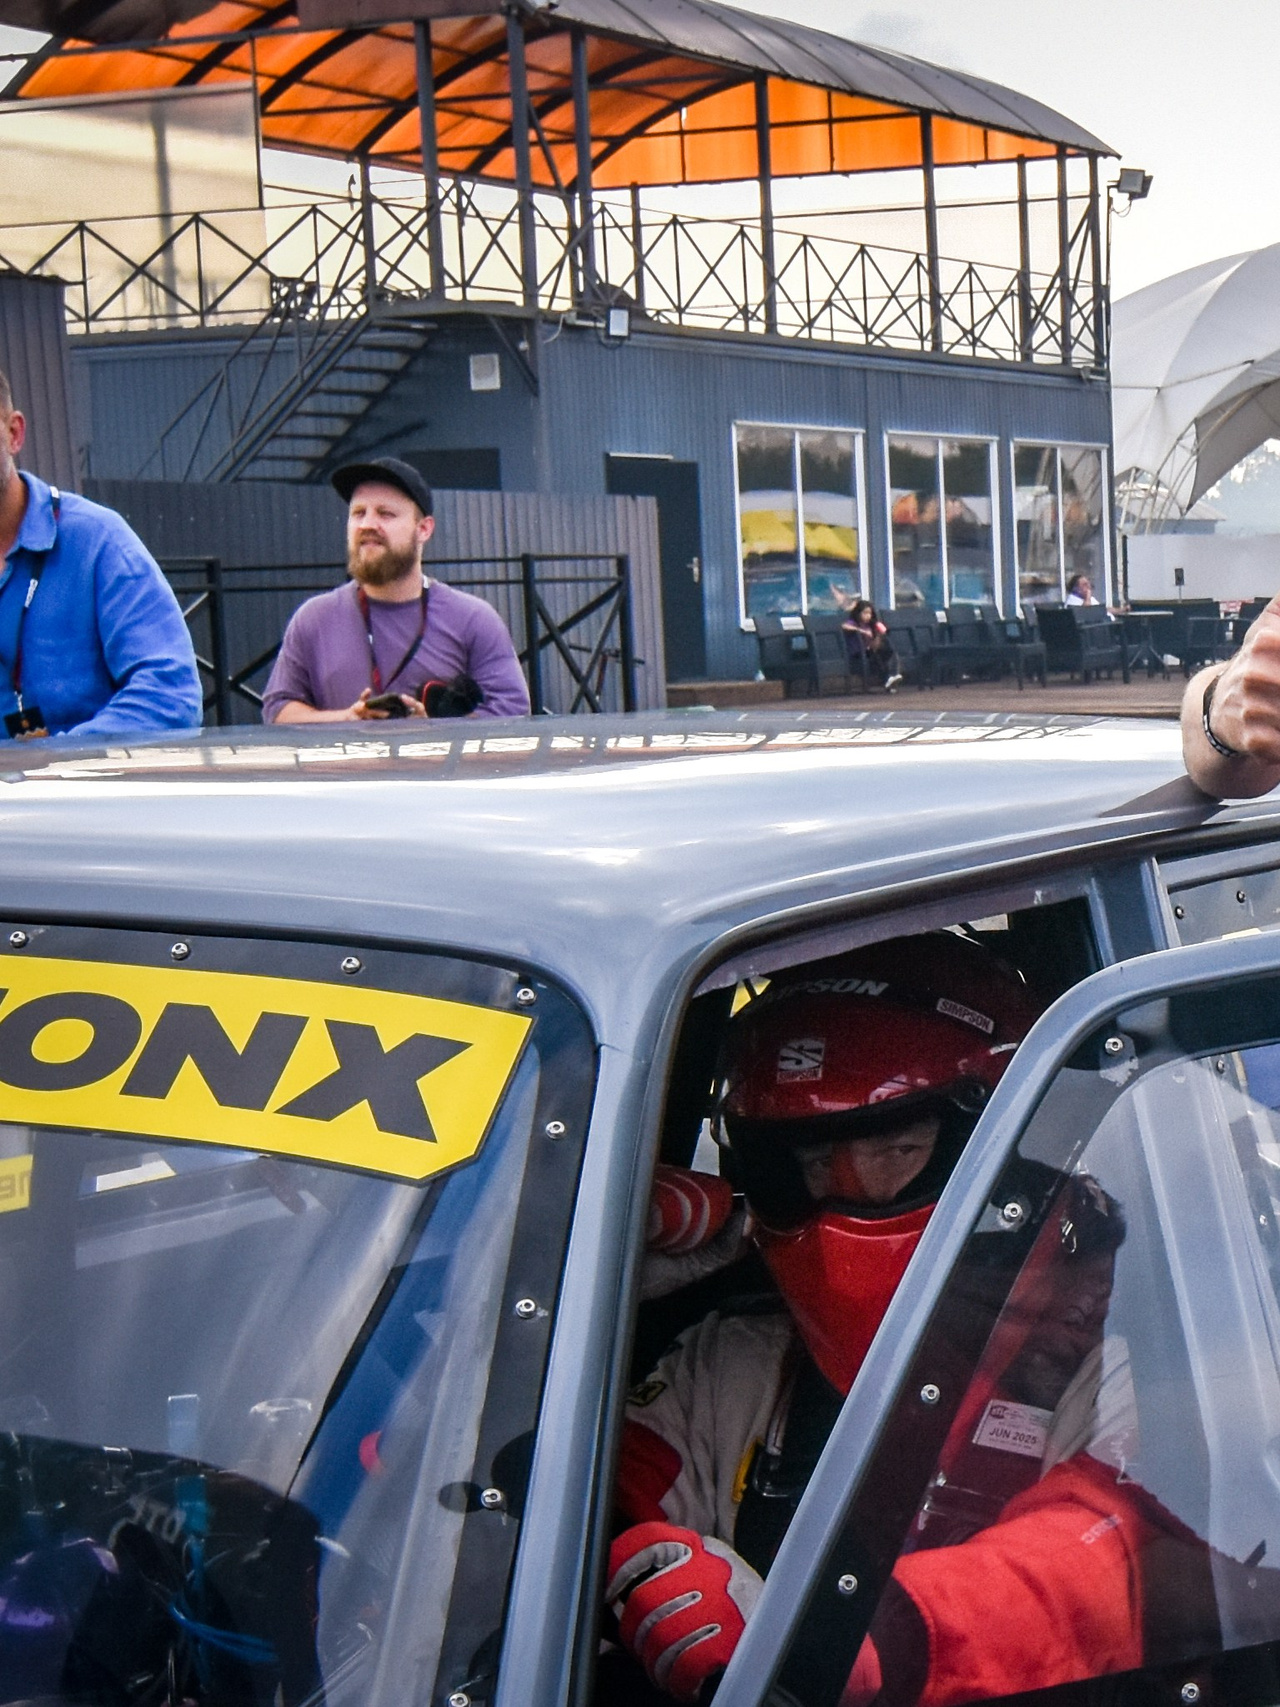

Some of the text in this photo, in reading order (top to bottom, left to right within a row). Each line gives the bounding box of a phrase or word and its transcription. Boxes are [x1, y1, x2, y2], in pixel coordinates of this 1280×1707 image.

[938, 1000, 993, 1033] SIMPSON
[0, 988, 474, 1144] ONX
[988, 1427, 1012, 1440] JUN
[1012, 1431, 1038, 1445] 2025
